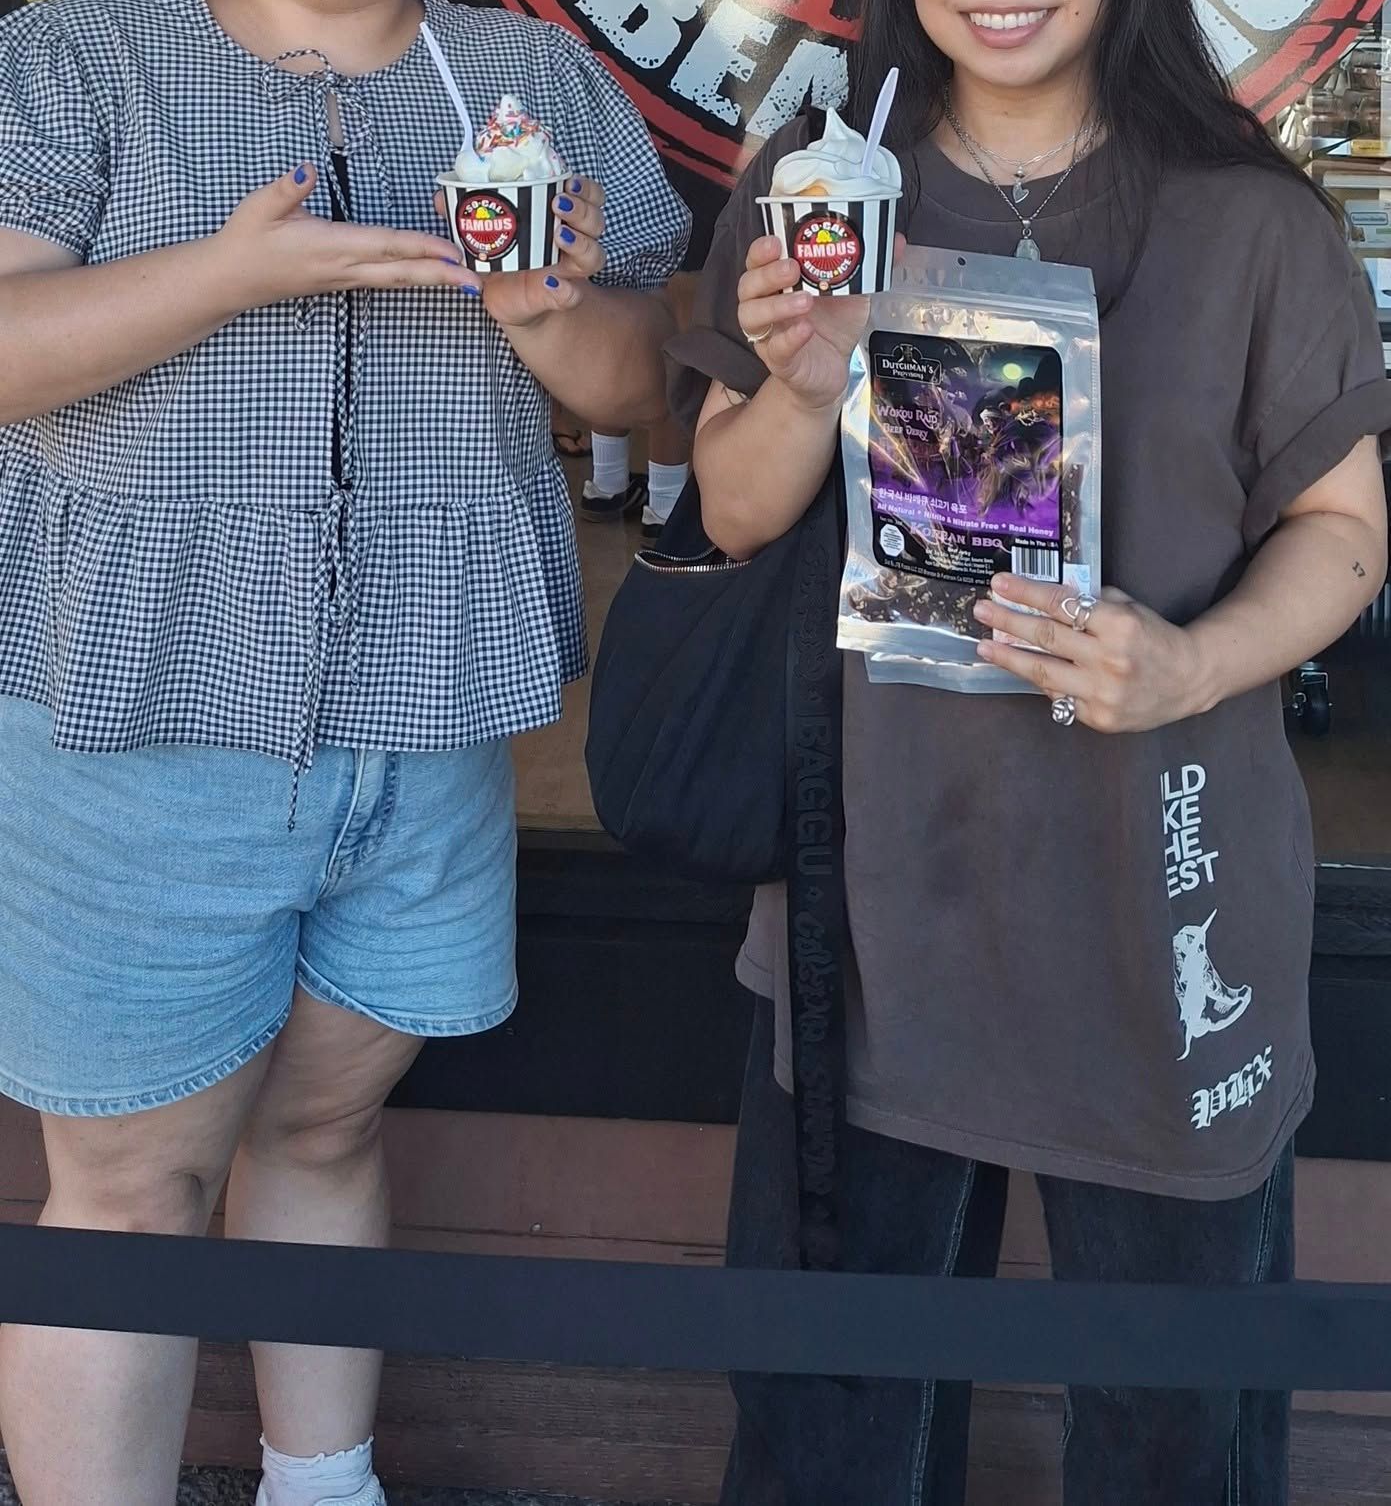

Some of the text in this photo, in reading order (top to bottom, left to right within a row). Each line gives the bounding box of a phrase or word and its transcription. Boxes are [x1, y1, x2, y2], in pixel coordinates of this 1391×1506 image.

[465, 199, 503, 213] SO CAL
[460, 217, 513, 231] FAMOUS
[804, 221, 846, 238] SO CAL
[465, 232, 508, 251] BEACH ICE
[797, 241, 857, 258] FAMOUS
[803, 258, 852, 279] BEACH ICE
[888, 504, 915, 516] Natural
[952, 517, 979, 528] Nitrate
[981, 521, 999, 530] Free
[1009, 523, 1026, 532] Real
[1028, 526, 1054, 537] Honey
[971, 536, 1007, 551] BBQ
[793, 715, 833, 877] BAGGU
